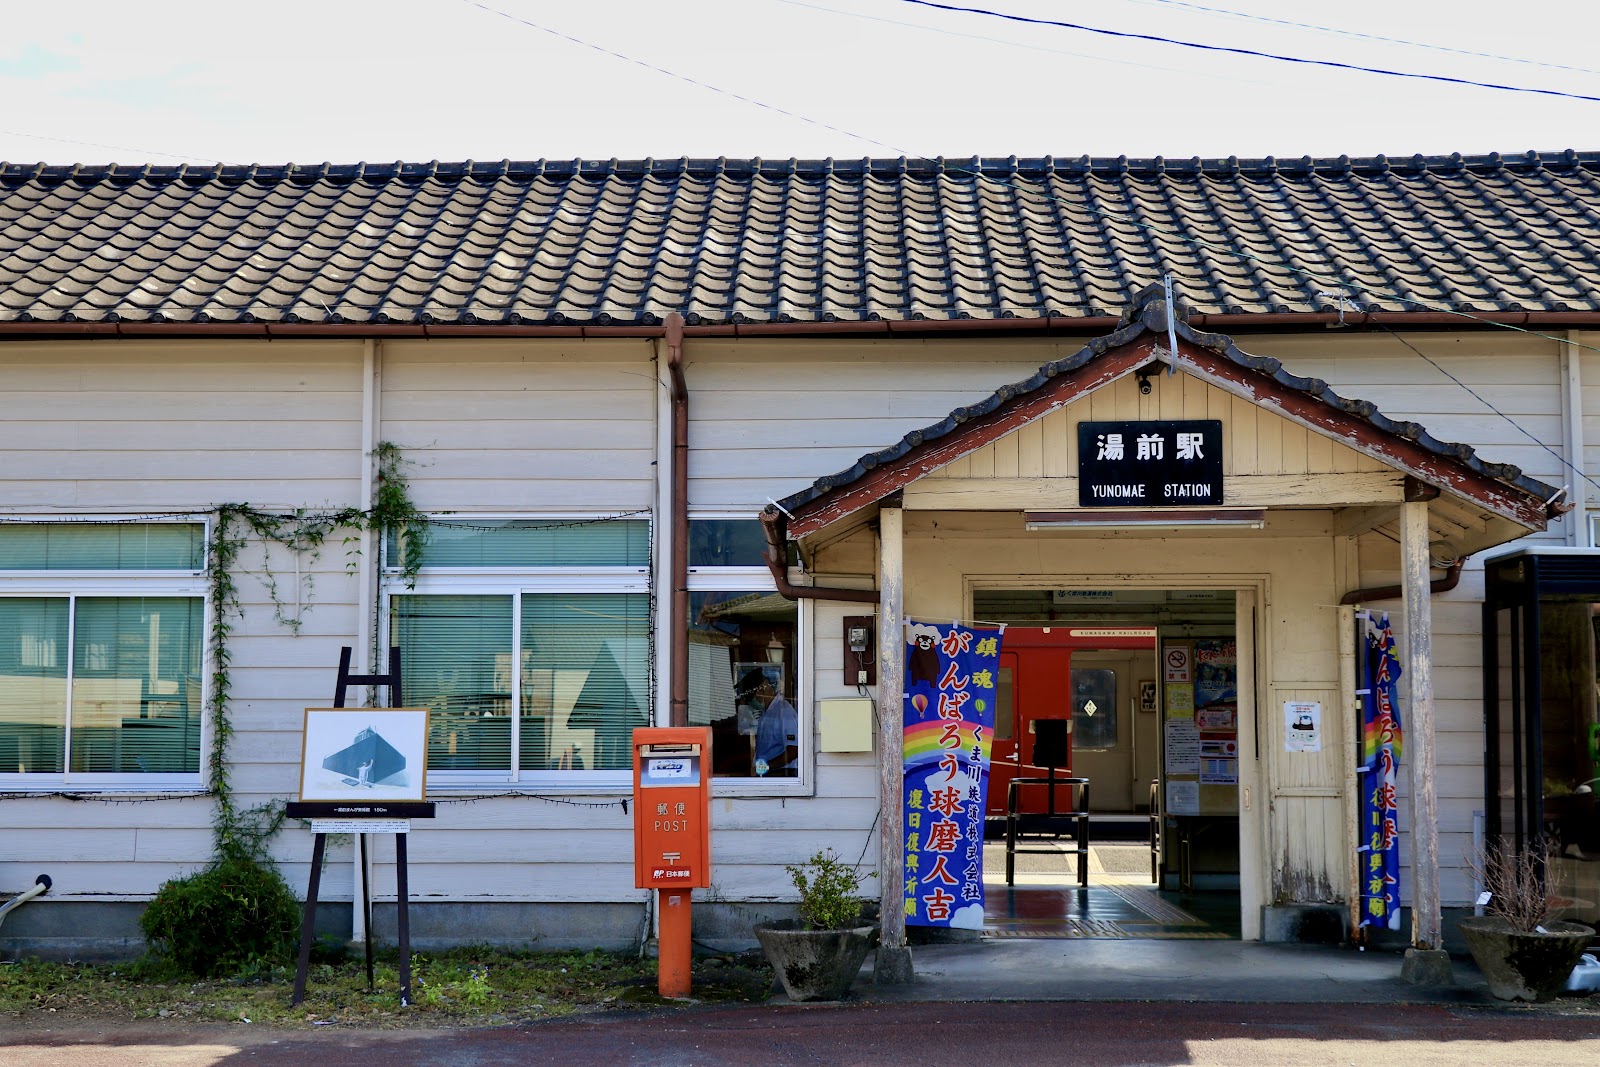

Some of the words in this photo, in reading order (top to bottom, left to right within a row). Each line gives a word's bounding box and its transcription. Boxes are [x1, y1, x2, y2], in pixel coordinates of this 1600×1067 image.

[1096, 433, 1204, 460] 湯前駅
[1092, 484, 1146, 498] YUNOMAE
[1164, 483, 1211, 497] STATION
[972, 636, 998, 689] 鎮魂
[922, 630, 973, 922] がんばろう球磨人吉
[657, 802, 686, 816] 郵便
[961, 725, 983, 901] くま川鉄道株式会社
[654, 820, 688, 832] POST
[904, 788, 925, 917] 復旧復興祈願
[666, 869, 690, 878] 日本郵便
